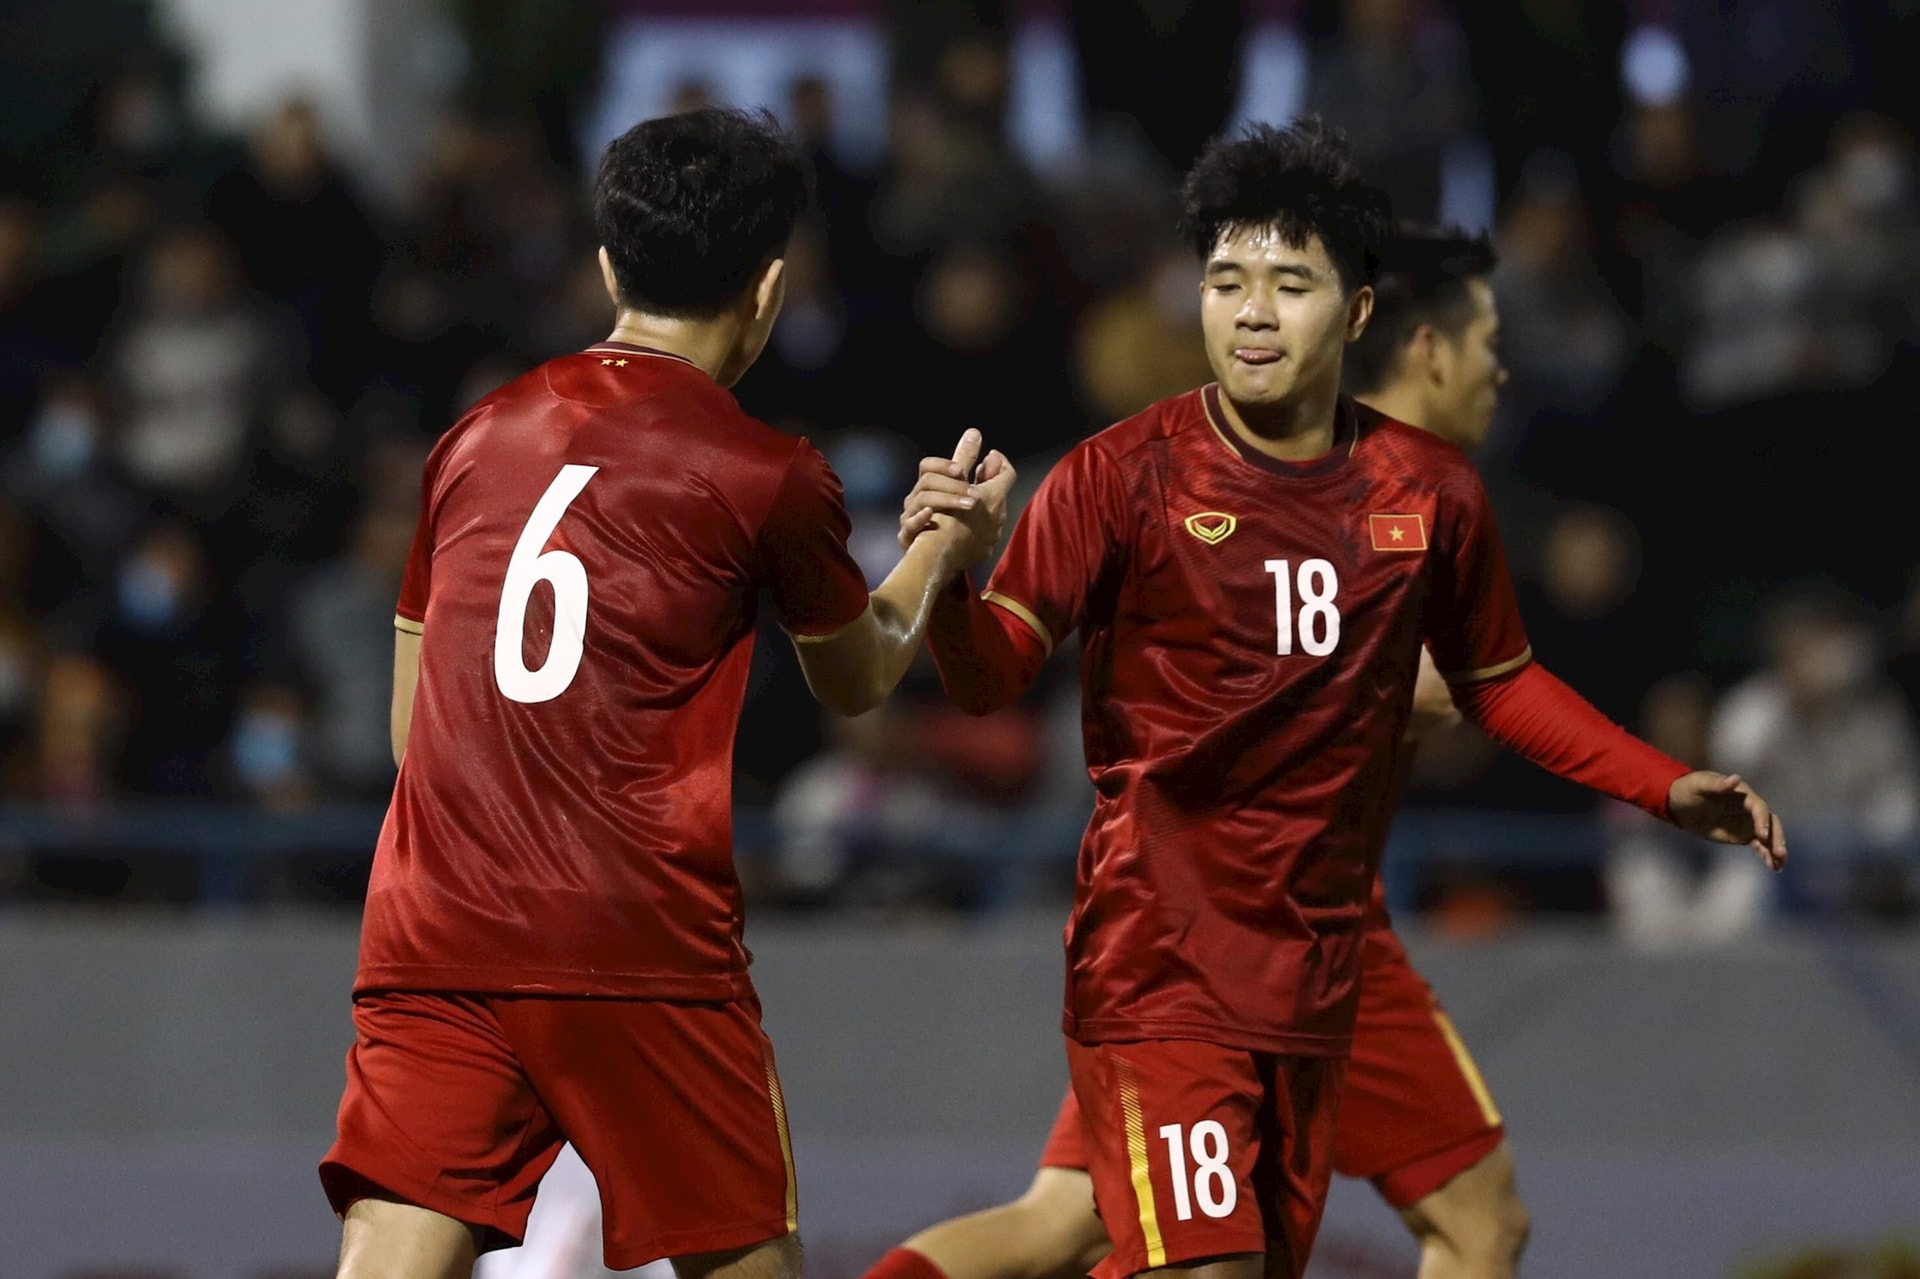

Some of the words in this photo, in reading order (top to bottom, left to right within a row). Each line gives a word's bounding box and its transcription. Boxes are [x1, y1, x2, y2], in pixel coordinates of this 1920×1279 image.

[494, 464, 600, 704] 6
[1264, 558, 1341, 657] 18
[1159, 1119, 1238, 1221] 18
